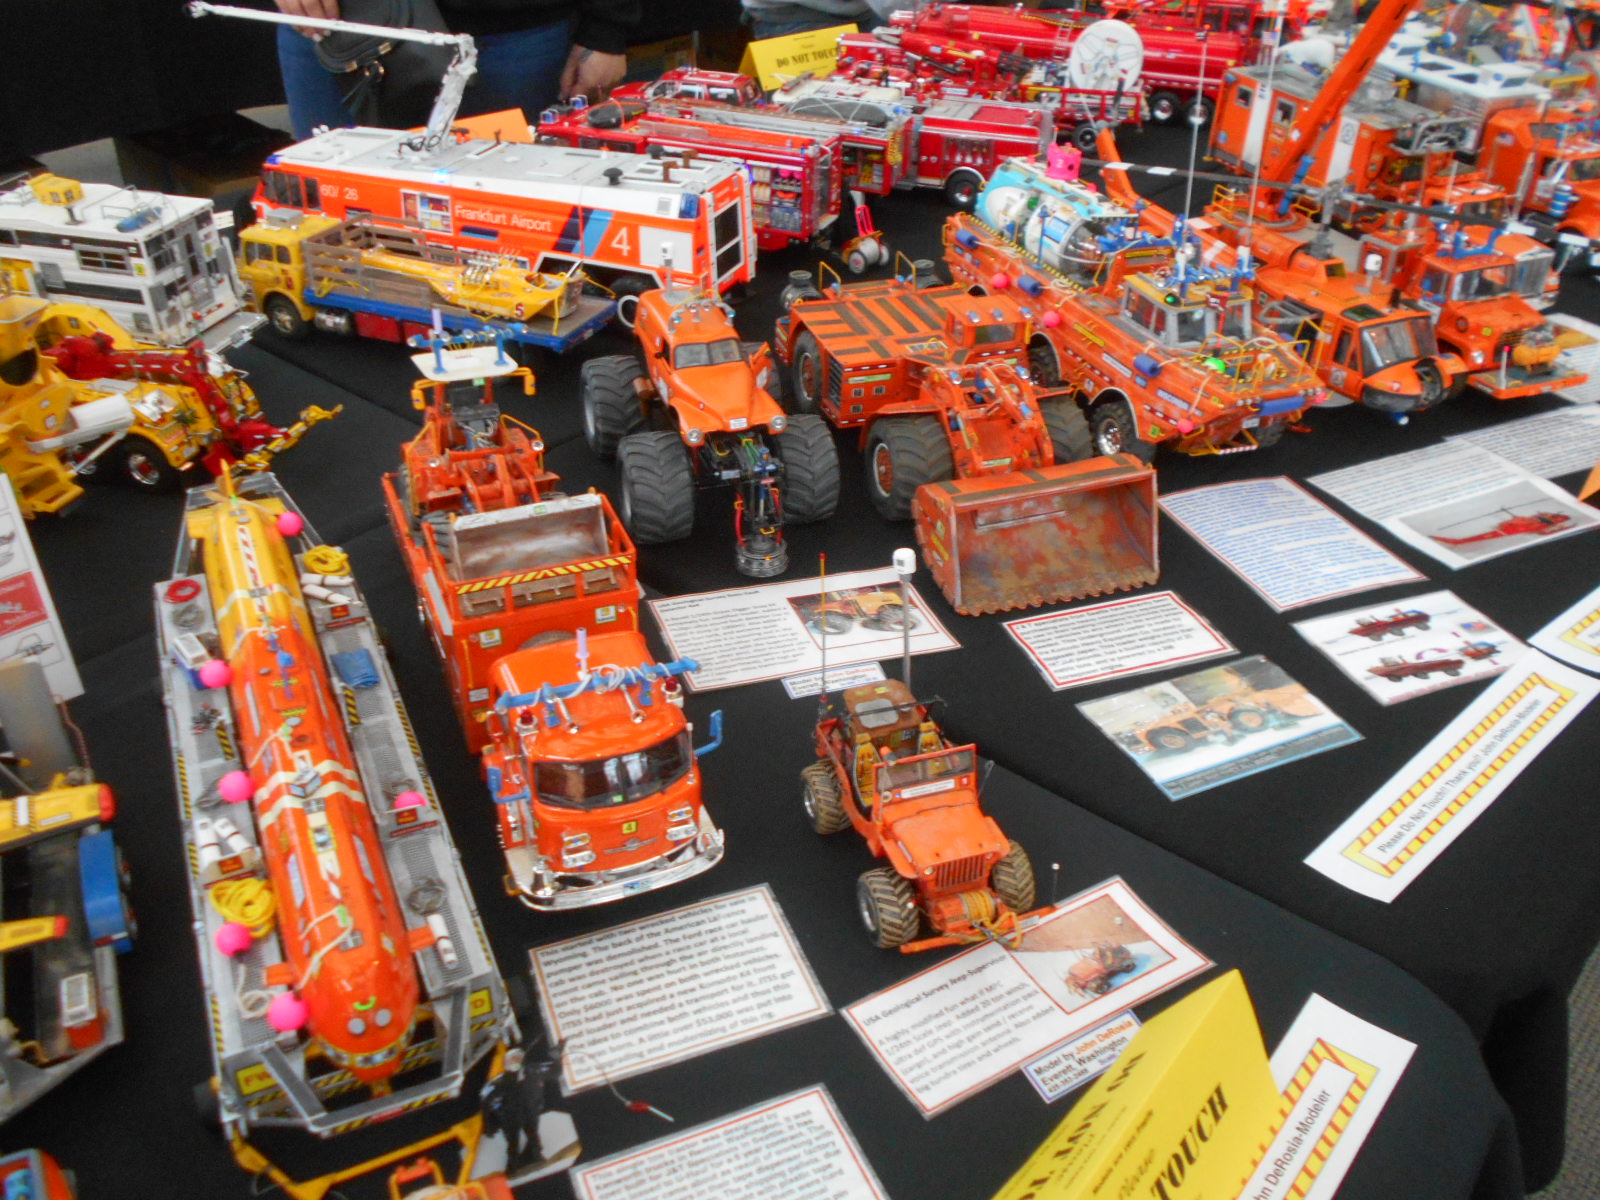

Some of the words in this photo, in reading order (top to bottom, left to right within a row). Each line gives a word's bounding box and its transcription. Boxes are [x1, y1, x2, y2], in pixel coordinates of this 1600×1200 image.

[776, 57, 790, 68] DO
[791, 53, 810, 64] NOT
[344, 187, 358, 201] 26
[454, 204, 508, 228] Frankfurt
[510, 213, 552, 233] Airport
[611, 226, 631, 256] 4
[1375, 829, 1406, 853] Please
[1408, 808, 1428, 822] Not
[1444, 768, 1470, 788] Thank
[1478, 739, 1499, 756] John
[539, 947, 559, 958] This
[560, 938, 594, 953] started
[595, 931, 617, 943] with
[618, 926, 637, 936] two
[638, 915, 676, 931] wrecked
[677, 905, 712, 920] vehicles
[542, 949, 588, 968] Wyoming.
[592, 943, 610, 954] The
[611, 937, 632, 949] back
[645, 929, 662, 939] the
[662, 917, 705, 935] American
[663, 935, 680, 945] The
[588, 958, 636, 978] destroyed
[639, 957, 678, 974] through
[678, 952, 694, 962] the
[862, 1014, 881, 1025] USA
[880, 995, 924, 1017] Geological
[921, 982, 949, 998] Survey
[954, 1004, 980, 1020] Added
[925, 1035, 944, 1048] GPS
[1075, 1034, 1129, 1068] Washington
[1032, 1055, 1062, 1076] Model
[1074, 1038, 1098, 1054] John
[1150, 1082, 1229, 1200] TOUCH
[1262, 1088, 1331, 1186] DeRosia-Modeler
